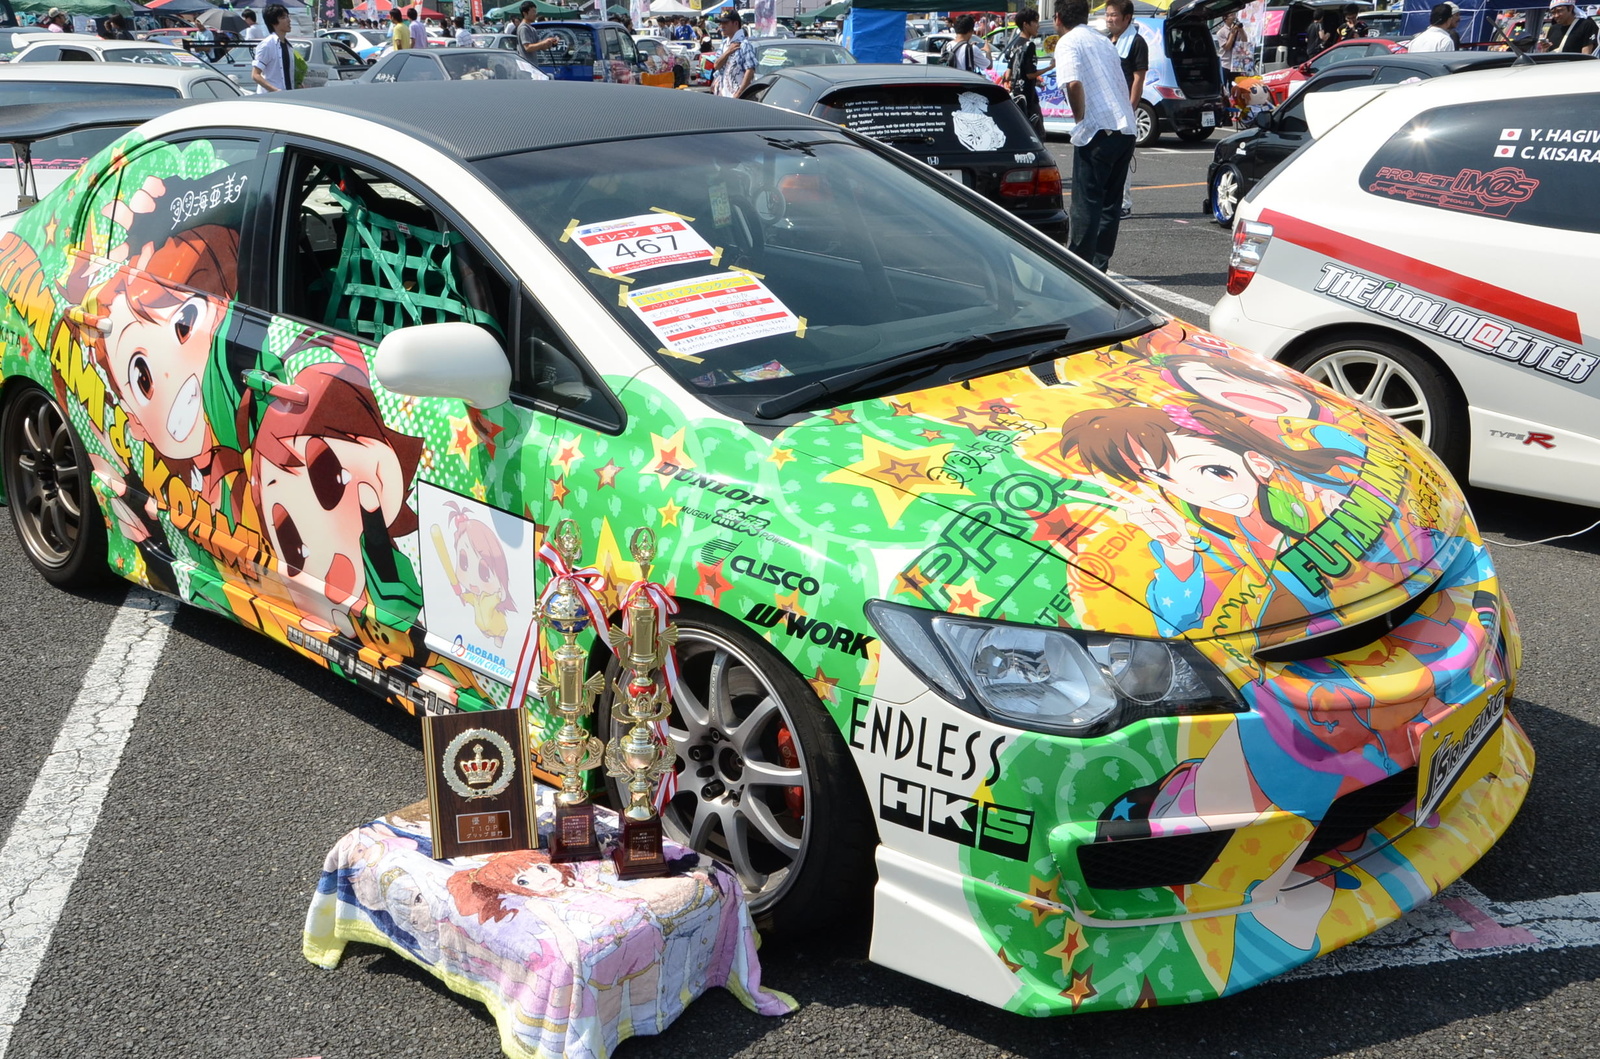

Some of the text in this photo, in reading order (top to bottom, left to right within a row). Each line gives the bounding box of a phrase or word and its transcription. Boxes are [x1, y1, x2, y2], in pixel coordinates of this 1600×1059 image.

[1375, 166, 1456, 188] PROJECT
[595, 224, 674, 243] ドレコン 番号
[615, 234, 678, 258] 467
[1314, 261, 1384, 307] THE
[1488, 428, 1557, 450] TYPE R
[654, 461, 770, 507] DUNLOP
[680, 505, 712, 521] MUGEN
[729, 554, 820, 597] CUSCO
[785, 610, 878, 661] WORK
[463, 652, 516, 679] TWIN CIRCUIT
[465, 643, 507, 668] MOBARA
[848, 696, 1007, 788] ENDLESS
[1447, 685, 1506, 770] RACING
[879, 772, 1036, 864] HKS
